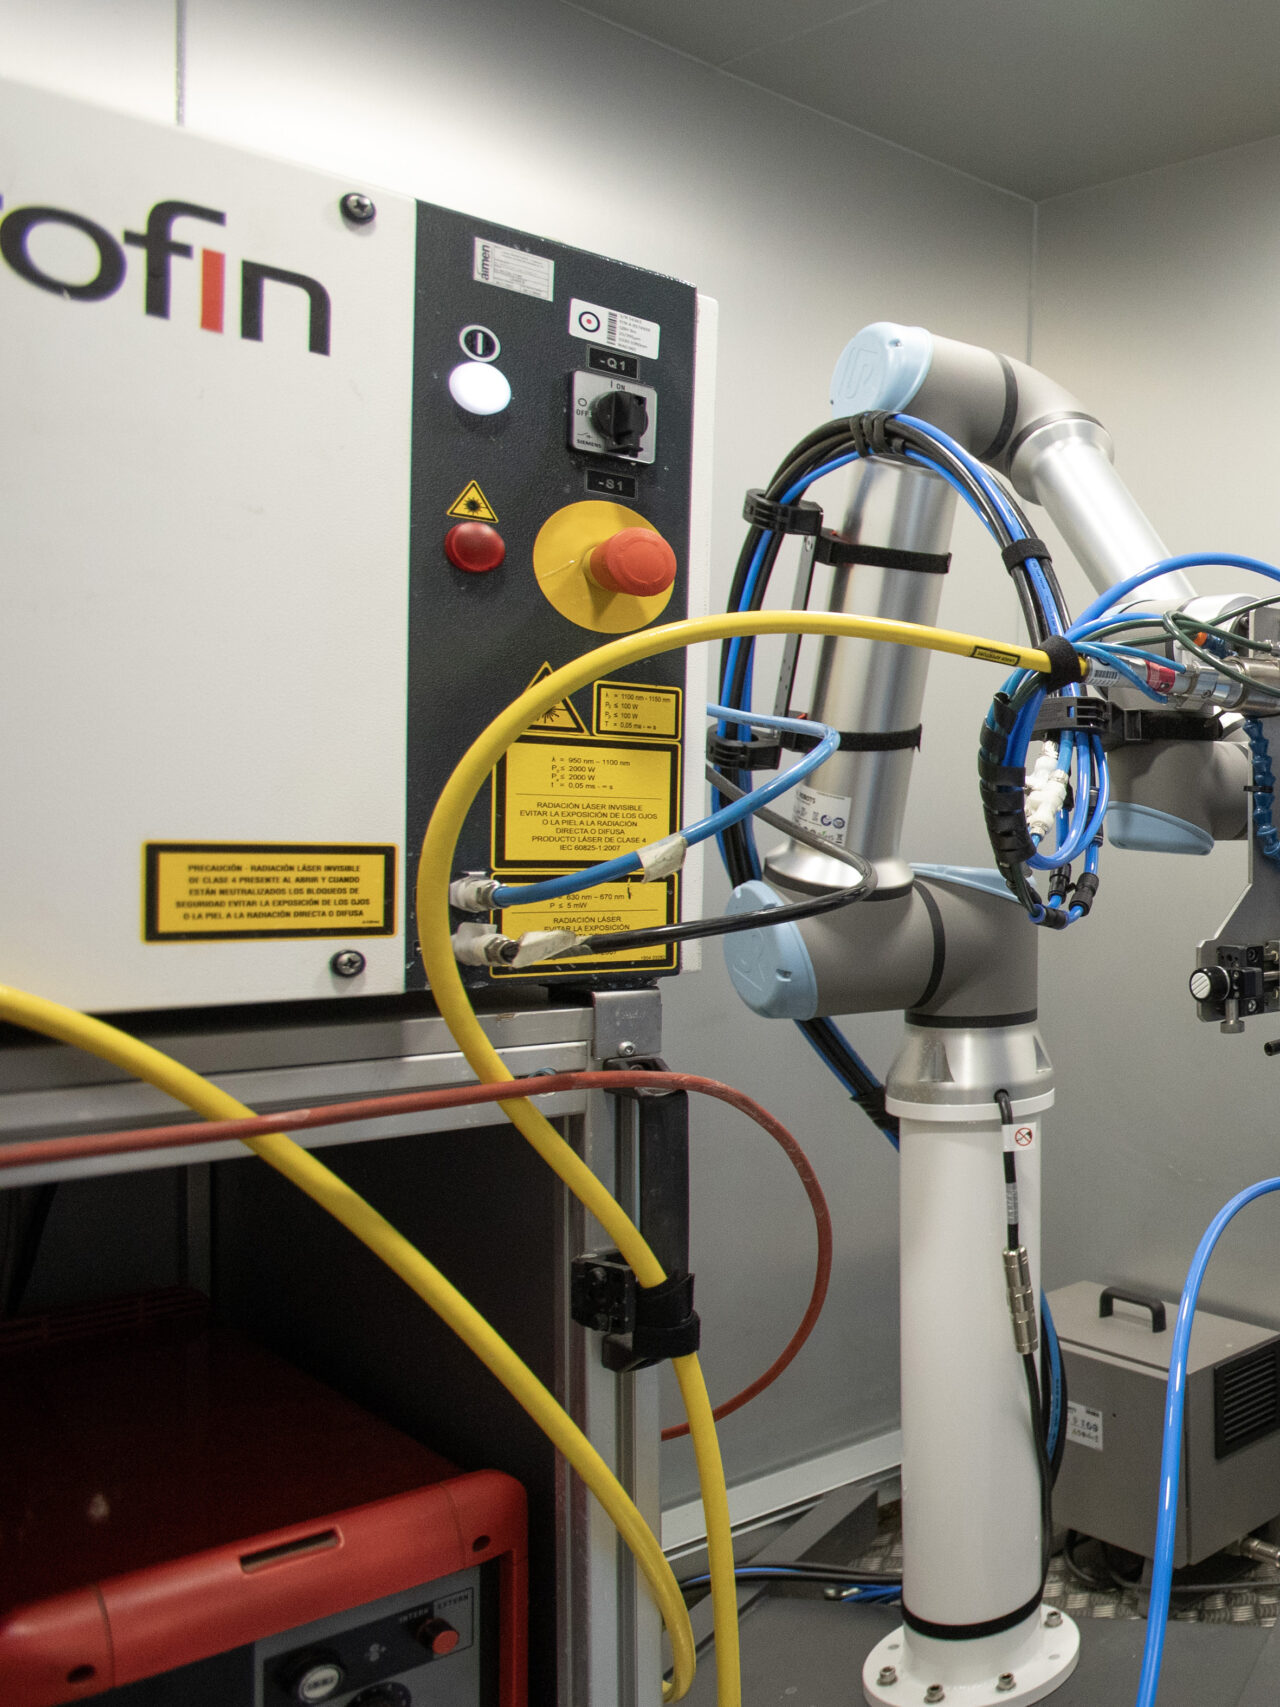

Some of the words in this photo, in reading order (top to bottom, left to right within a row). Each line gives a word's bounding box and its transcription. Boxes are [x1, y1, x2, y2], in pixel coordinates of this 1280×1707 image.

[0, 194, 331, 357] ofin
[616, 383, 626, 391] ON
[576, 408, 589, 416] OFF
[576, 439, 602, 449] SIEMENS
[536, 801, 580, 810] RADIACIÓN
[581, 802, 606, 811] LÁSER
[561, 810, 608, 818] EXPOSICIÓN
[531, 835, 577, 843] PRODUCTO
[578, 835, 603, 843] LÁSER
[187, 864, 243, 872] PRECAUCIÓN
[250, 863, 295, 872] RADIACIÓN
[297, 864, 322, 872] LÁSER
[188, 876, 199, 884] DE
[202, 876, 228, 884] CLASE
[239, 876, 279, 884] PRESENTE
[283, 876, 292, 884] AL
[189, 887, 216, 896] ESTÁN
[219, 887, 287, 896] NEUTRALIZADOS
[289, 887, 304, 895] LOS
[306, 887, 347, 895] BLOQUEOS
[176, 900, 226, 908] SEGURIDAD
[228, 899, 257, 908] EVITAR
[260, 899, 270, 907] LA
[272, 898, 319, 907] EXPOSICIÓN
[333, 898, 349, 906] LOS
[350, 898, 370, 906] OJOS
[192, 912, 203, 920] LA
[234, 911, 245, 919] LA
[247, 910, 291, 919] RADIACIÓN
[293, 910, 326, 918] DIRECTA
[336, 909, 364, 917] DIFUSA
